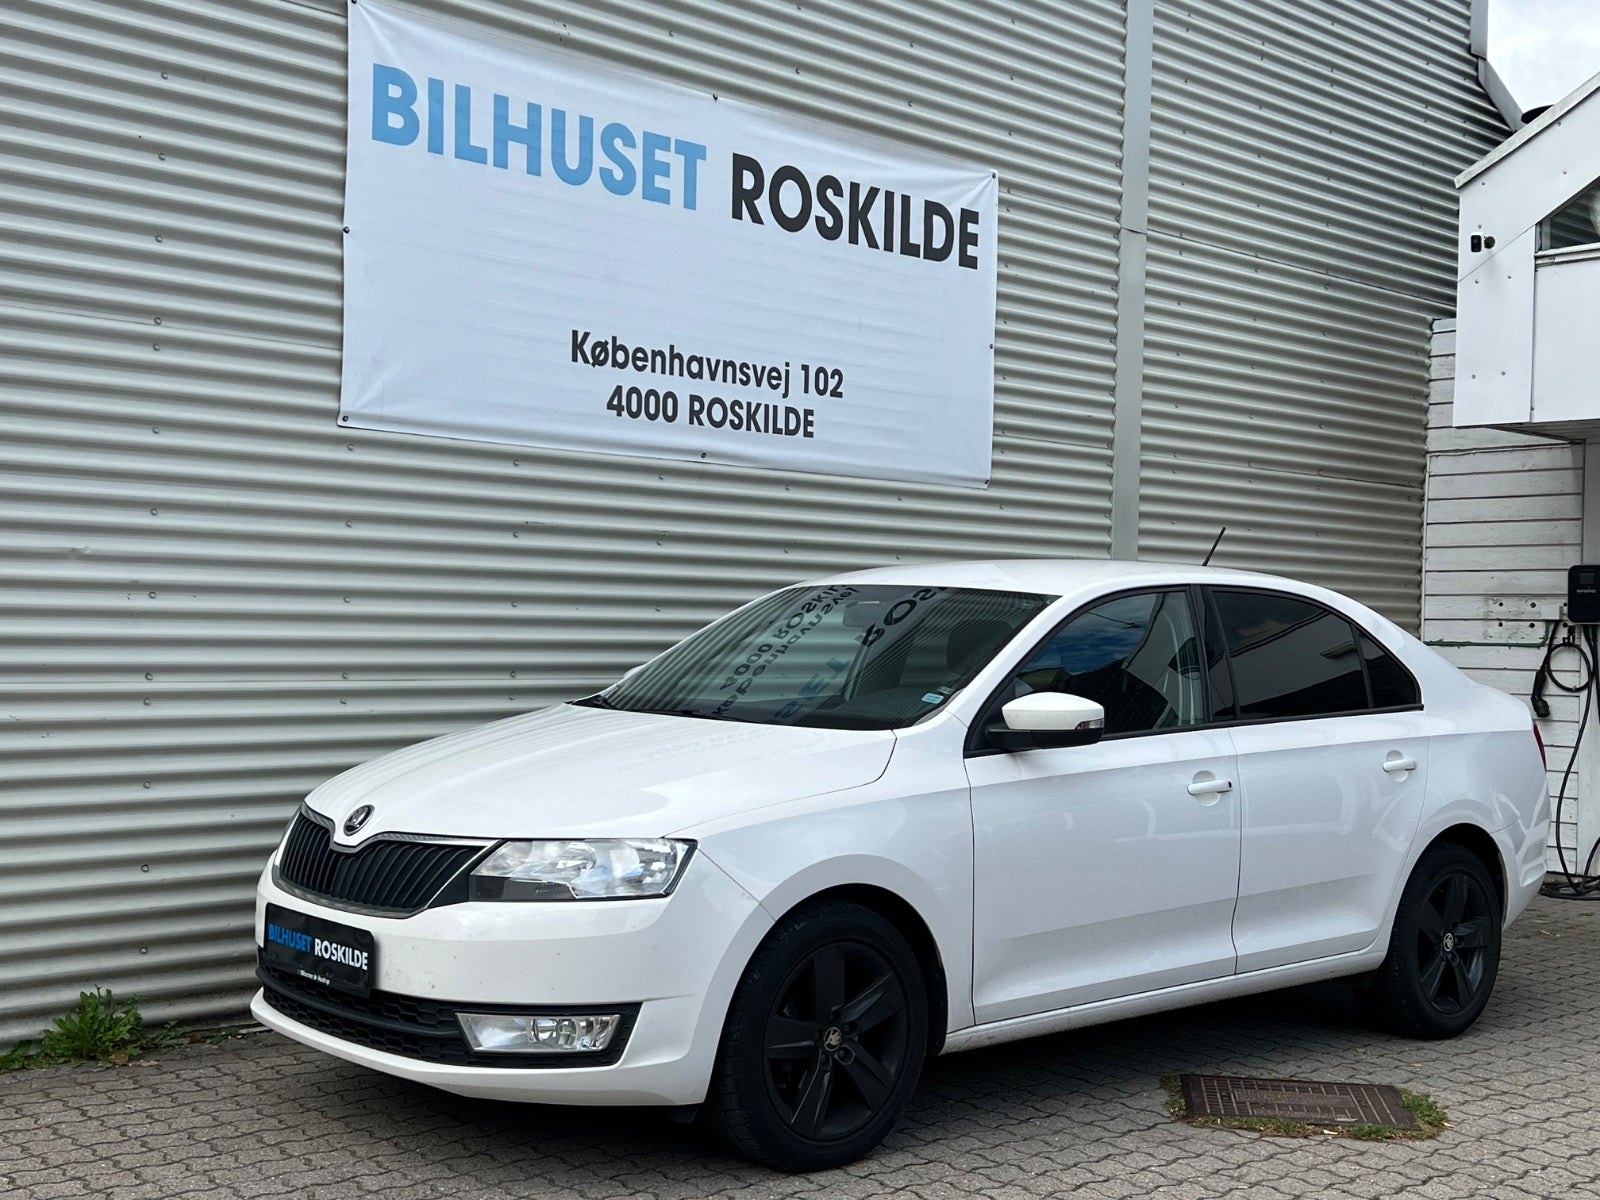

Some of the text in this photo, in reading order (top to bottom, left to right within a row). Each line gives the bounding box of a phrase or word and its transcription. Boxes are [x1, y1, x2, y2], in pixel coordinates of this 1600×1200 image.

[370, 63, 980, 270] BILHUSET ROSKILDE
[571, 329, 844, 399] Københavnsvej 102
[606, 384, 815, 439] 4000 ROSKILDE
[267, 922, 369, 971] BILHUSET ROSKILDE
